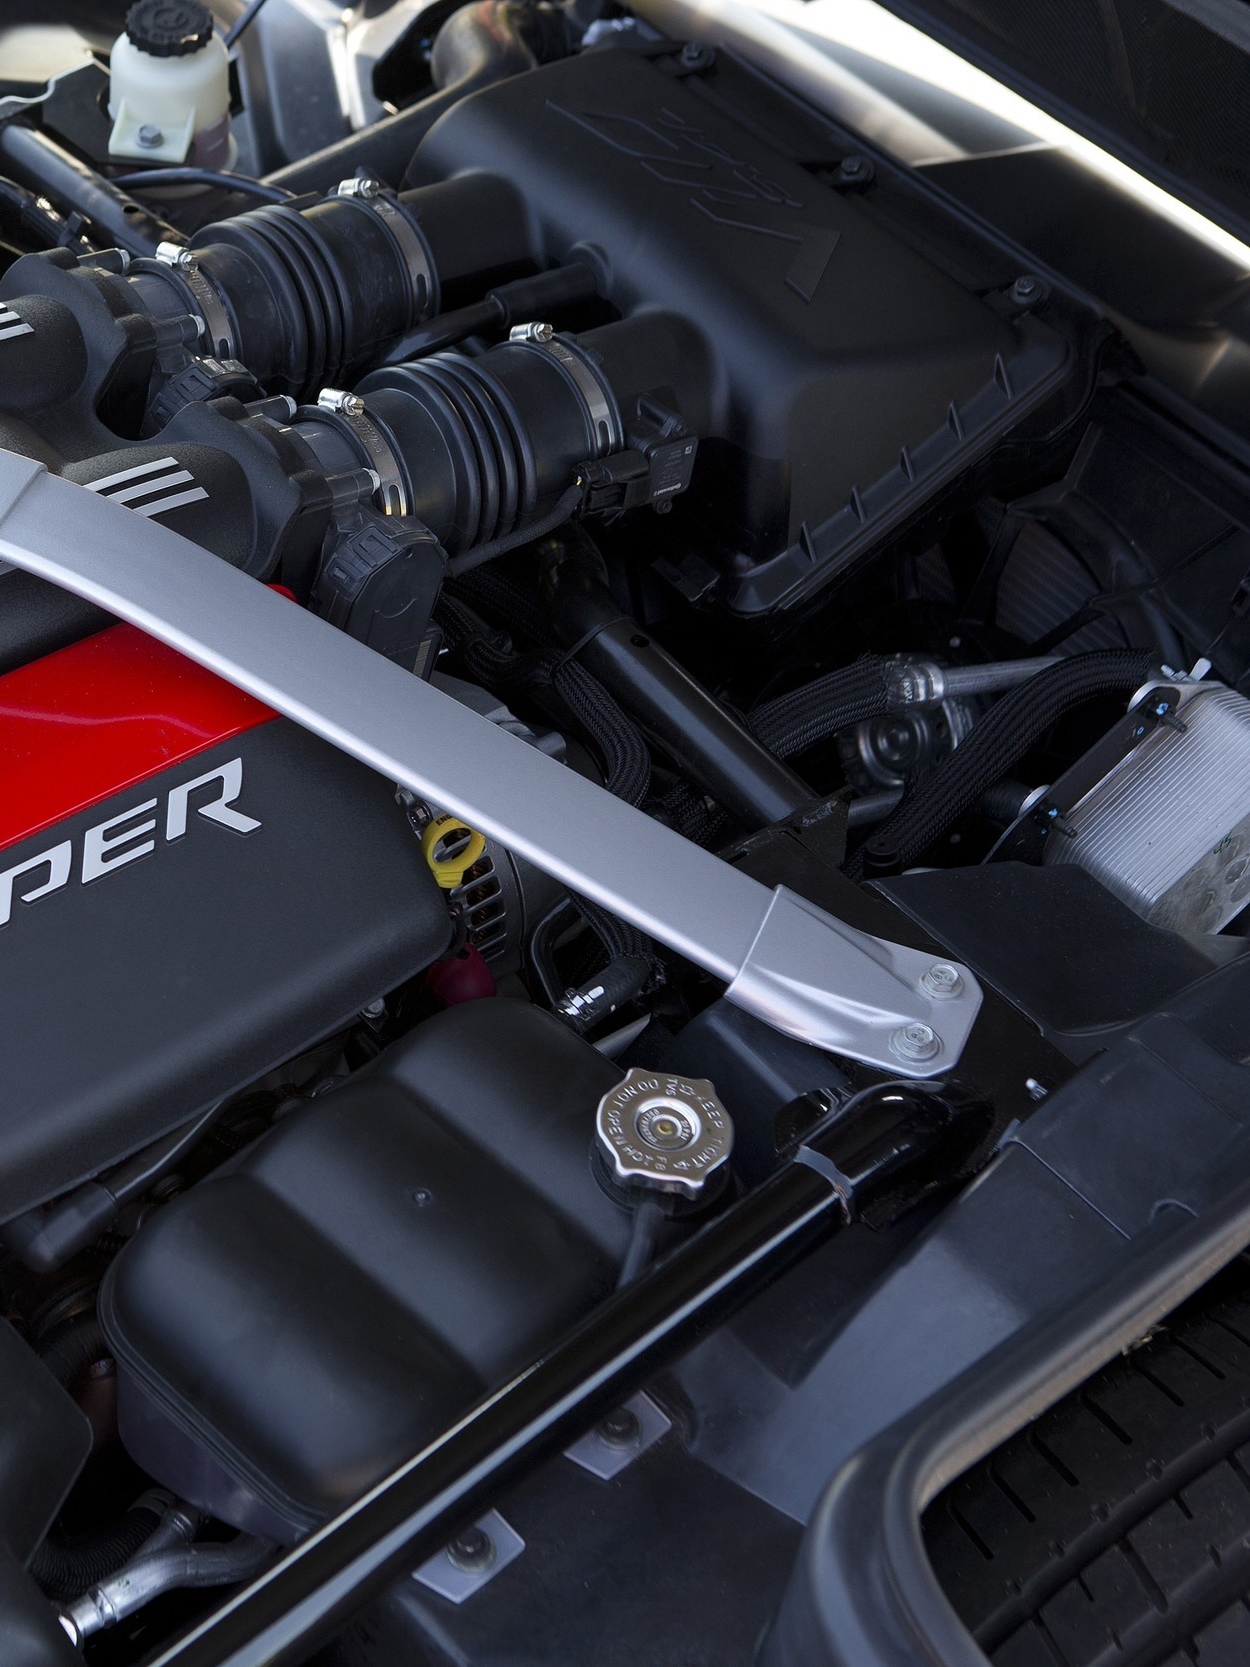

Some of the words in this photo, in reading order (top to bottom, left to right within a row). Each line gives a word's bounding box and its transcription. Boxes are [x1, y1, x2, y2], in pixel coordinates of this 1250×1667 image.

[613, 1085, 639, 1108] NOT
[638, 1078, 660, 1092] DO
[607, 1110, 627, 1146] OPEN
